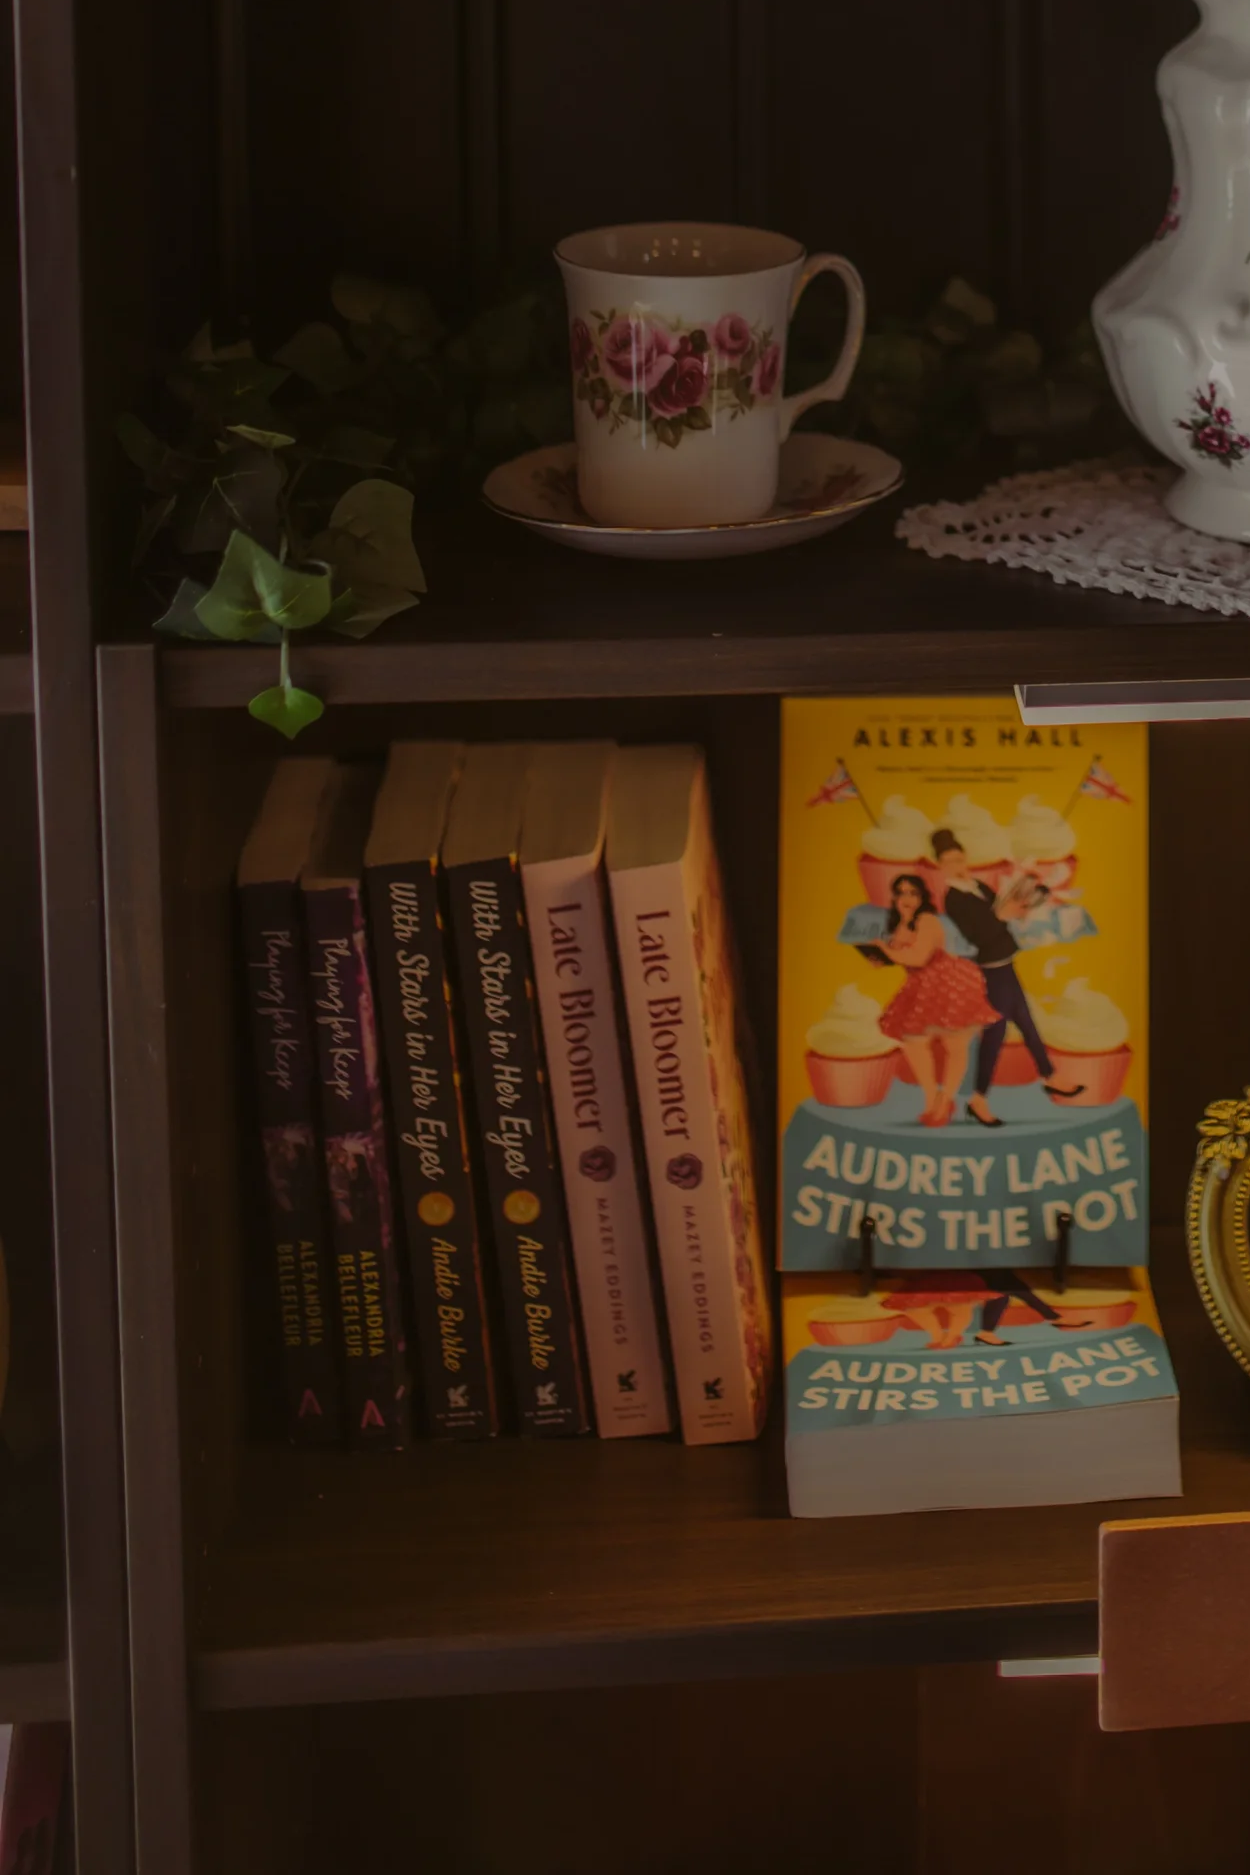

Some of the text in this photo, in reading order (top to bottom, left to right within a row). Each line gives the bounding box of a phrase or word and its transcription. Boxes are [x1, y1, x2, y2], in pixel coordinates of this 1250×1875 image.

[853, 727, 1083, 748] ALEXIS HALL
[250, 930, 300, 1090] Playing for Keeps
[311, 938, 360, 1101] Playing for Keeps
[389, 881, 448, 1181] With Stars in Her Eyes
[469, 881, 533, 1179] With Stars in Her Eyes
[547, 904, 603, 1133] Late Bloomer
[636, 911, 690, 1140] Late Bloomer
[802, 1128, 1132, 1197] AUDREY LANE
[516, 1235, 547, 1298] Andie
[596, 1197, 628, 1345] MAZEY EDDINGS
[682, 1205, 714, 1353] MAZEY EDDINGS
[937, 1206, 1032, 1251] THE
[276, 1244, 301, 1346] BELLEFLEUR
[299, 1240, 323, 1346] ALEXANDRIA
[338, 1254, 363, 1357] BELLEFLEUR
[359, 1250, 385, 1358] ALEXANDRIA
[431, 1237, 467, 1373] Andie Burke
[524, 1303, 555, 1371] Burke
[797, 1357, 1161, 1412] STIRS THE POT
[808, 1336, 1146, 1385] AUDREY LANE
